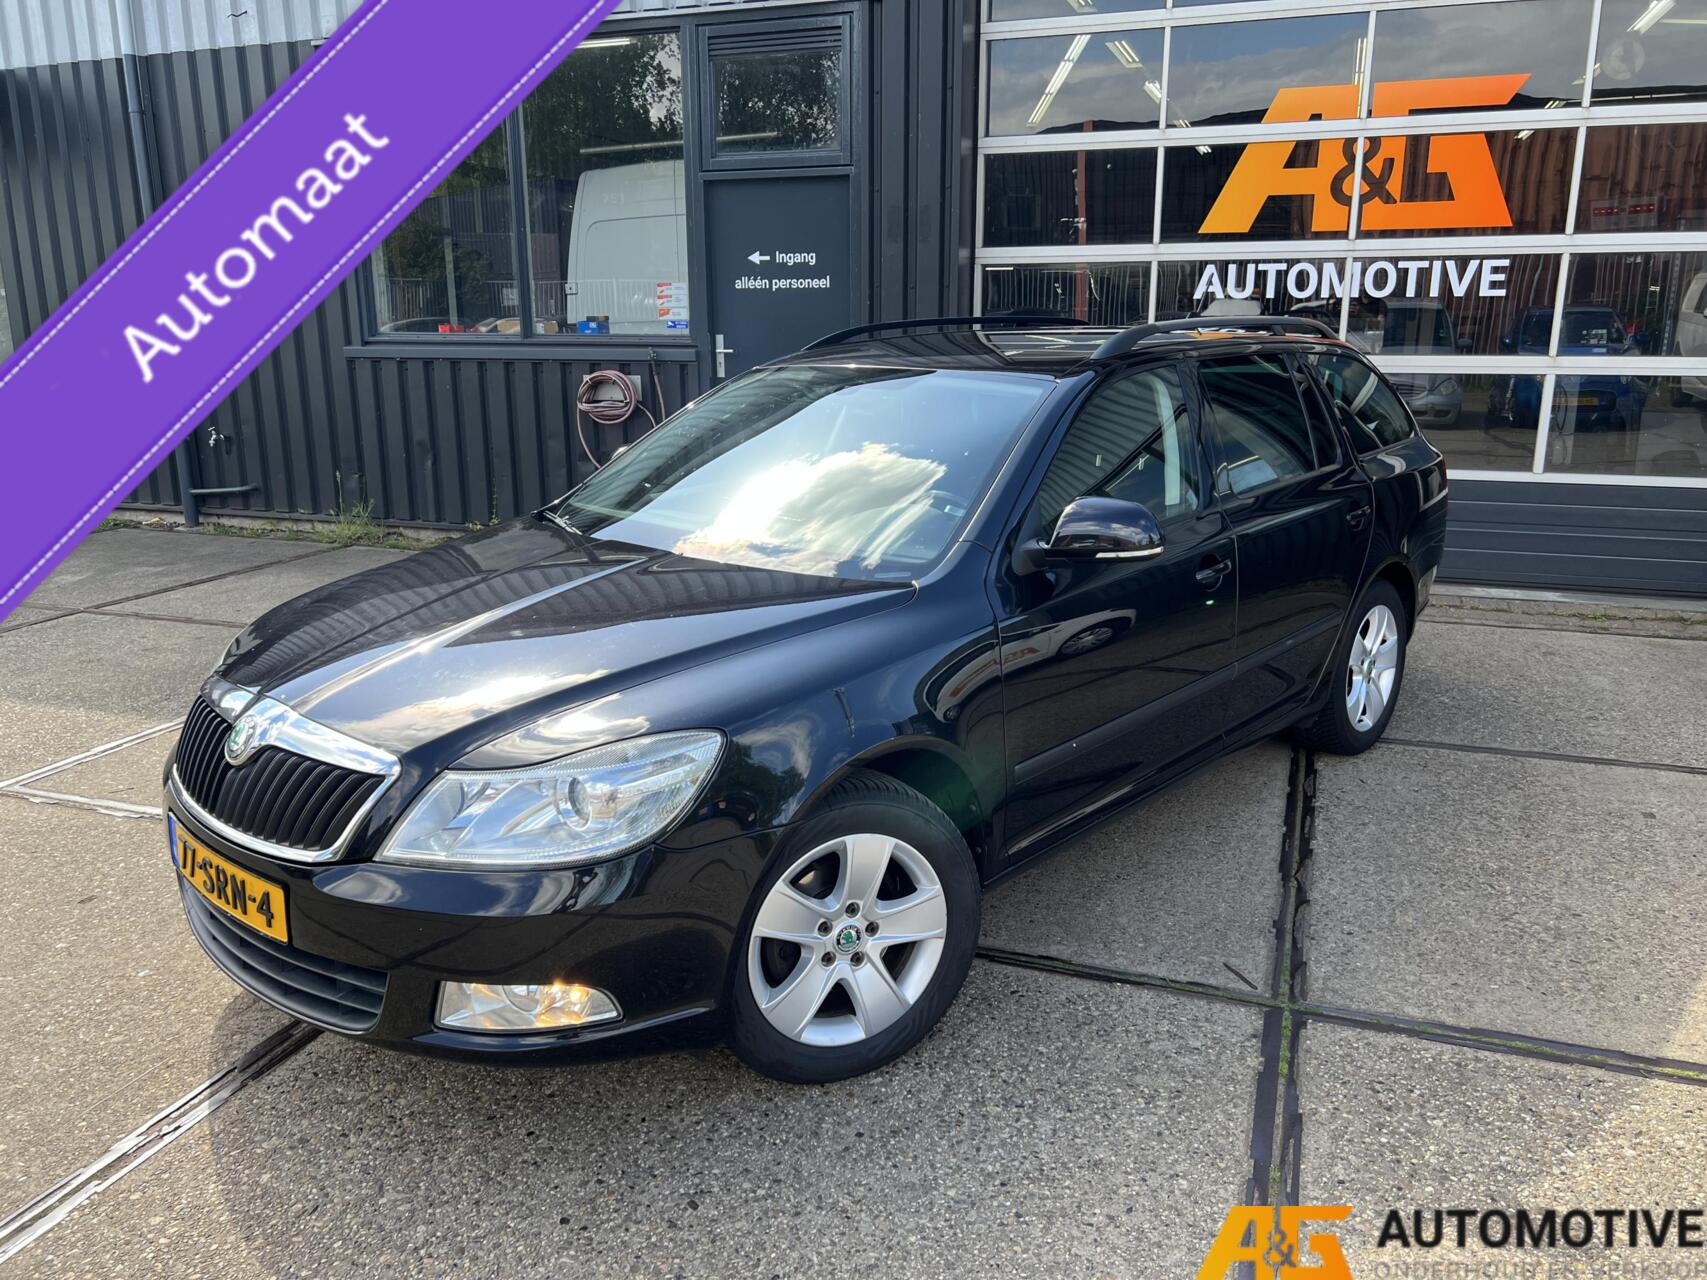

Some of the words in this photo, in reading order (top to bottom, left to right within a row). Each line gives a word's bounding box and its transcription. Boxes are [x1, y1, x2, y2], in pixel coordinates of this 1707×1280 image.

[1198, 73, 1531, 233] A&G
[776, 250, 816, 266] Ingang
[735, 276, 770, 289] alléén
[772, 275, 830, 292] personeel
[1193, 258, 1510, 300] AUTOMOTIVE
